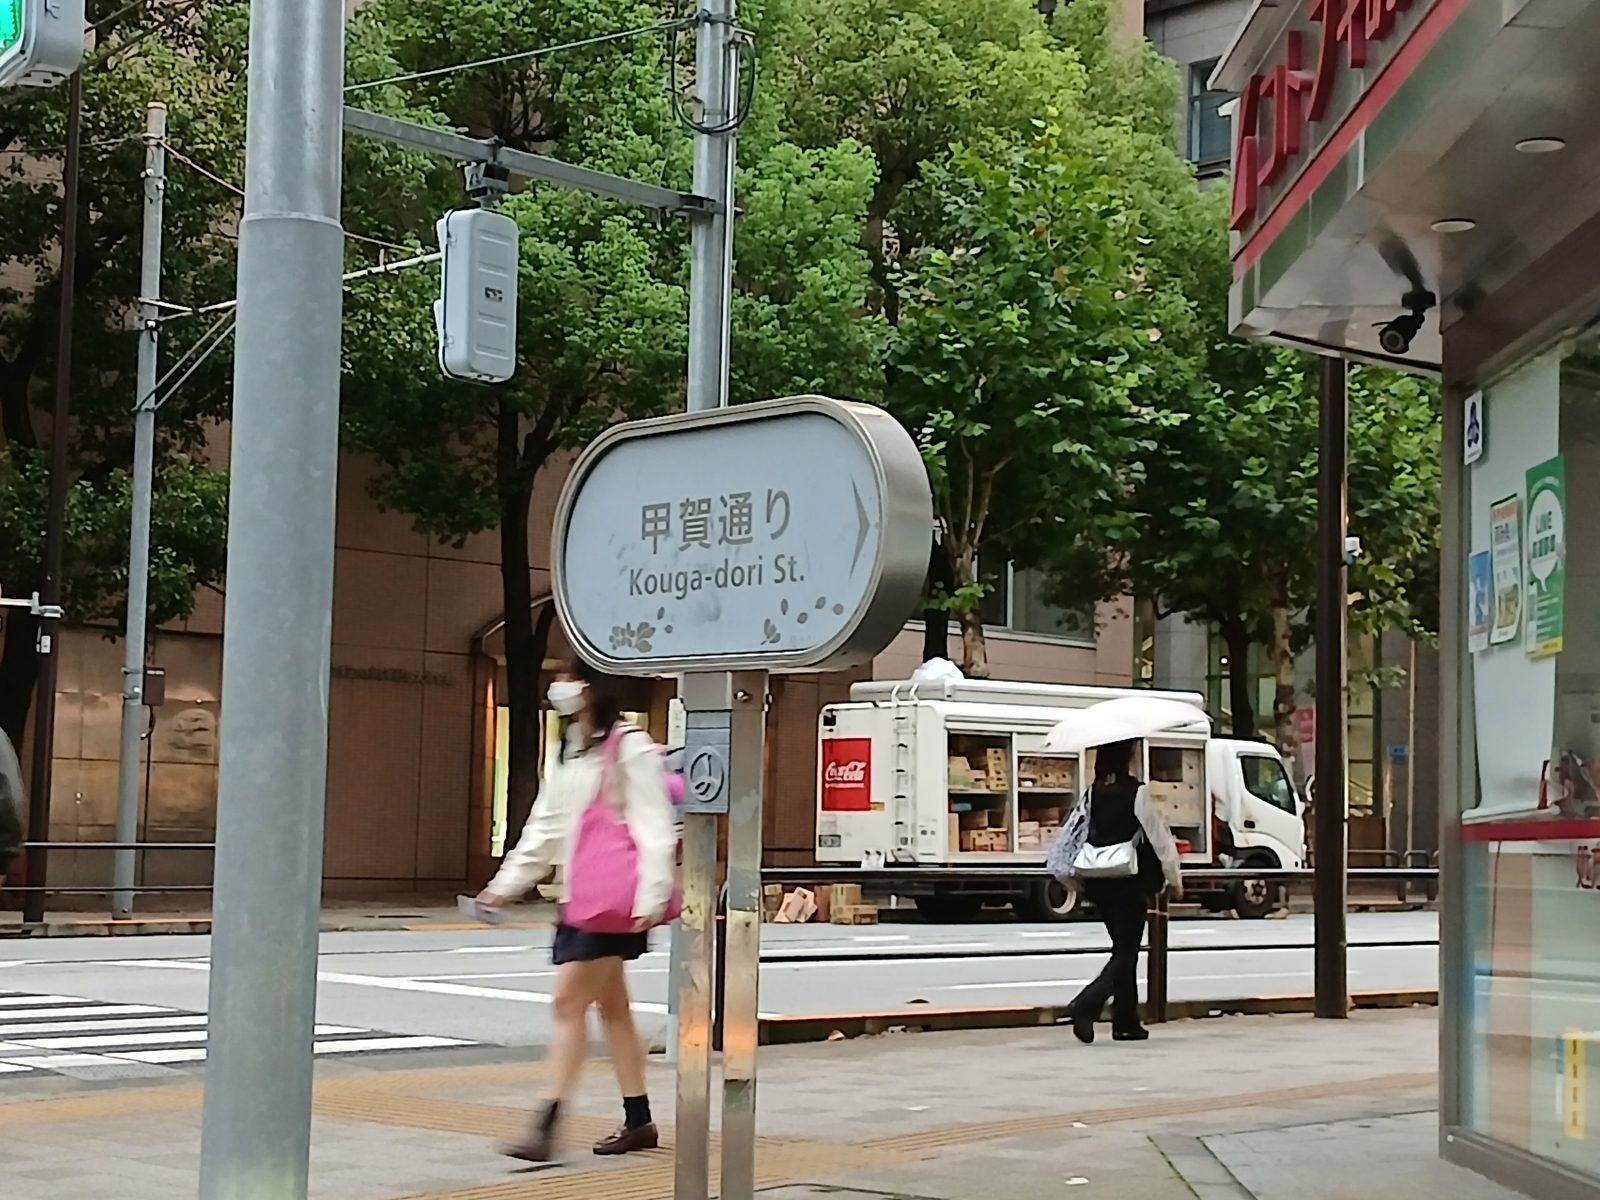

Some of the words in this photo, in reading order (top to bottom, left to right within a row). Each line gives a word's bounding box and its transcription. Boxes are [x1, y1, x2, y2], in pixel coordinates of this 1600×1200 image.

[640, 488, 791, 555] 甲賀通り
[629, 555, 763, 600] Kouga-dori
[774, 554, 805, 584] St.
